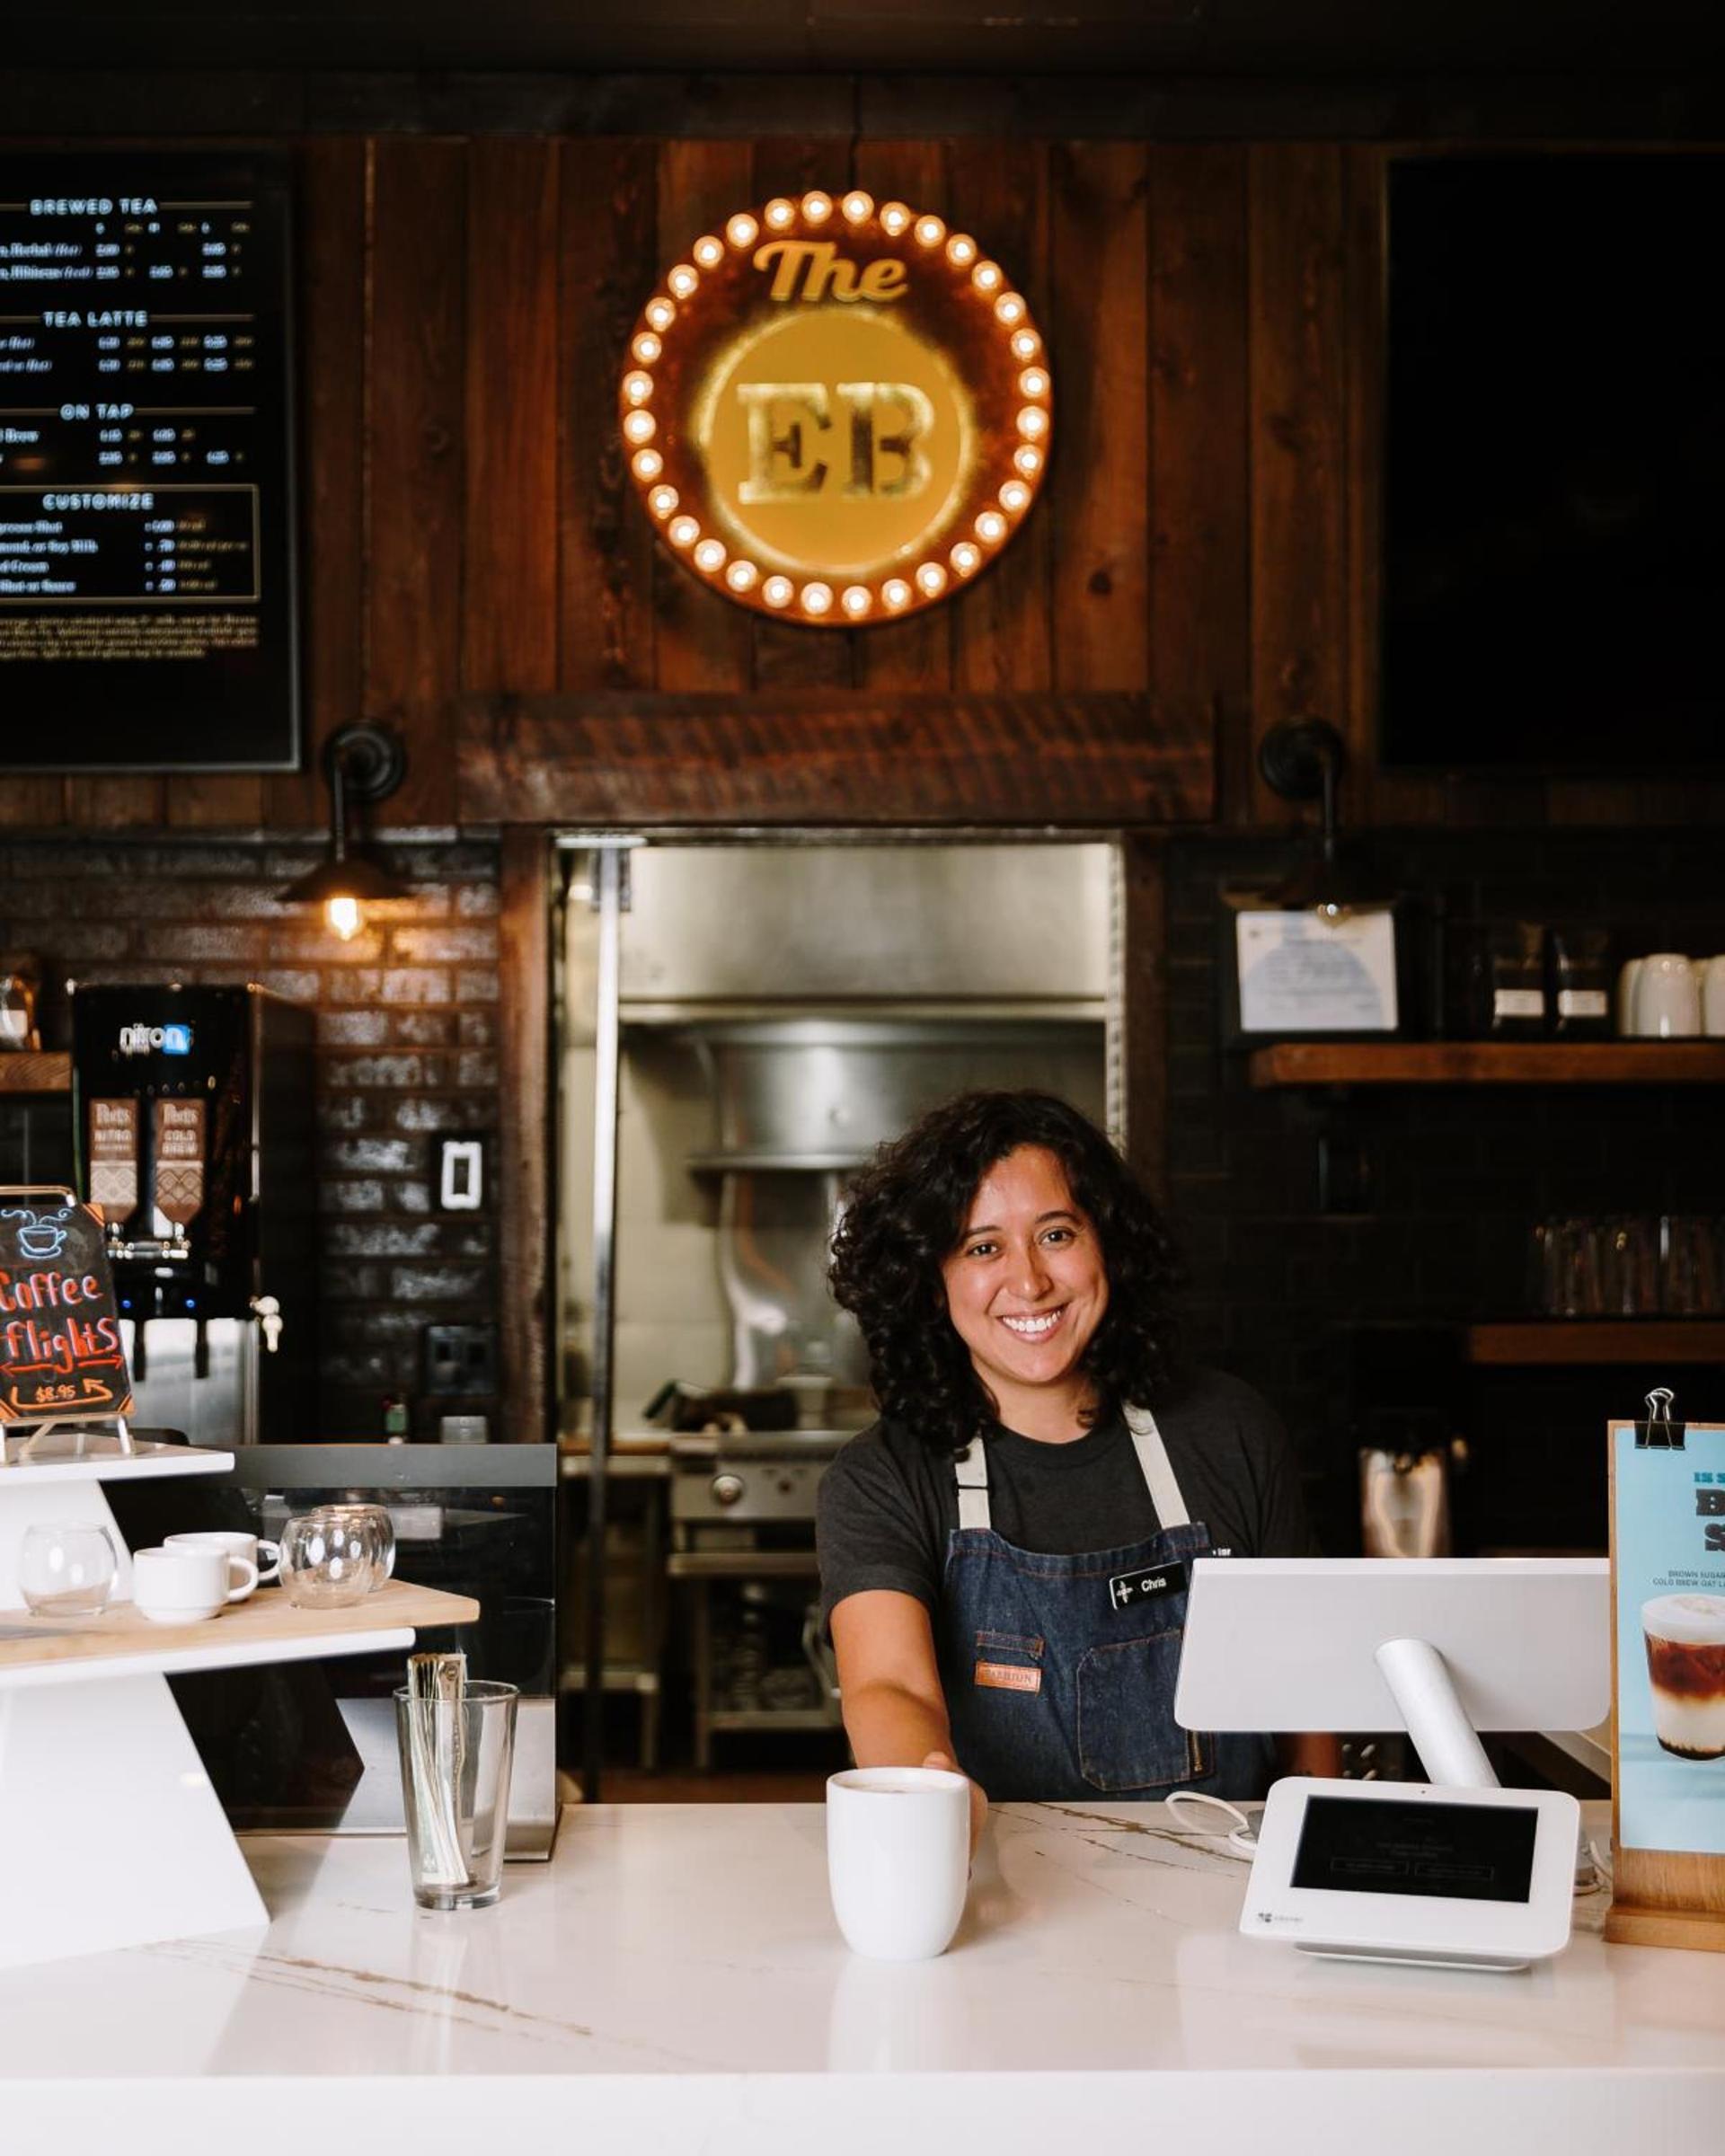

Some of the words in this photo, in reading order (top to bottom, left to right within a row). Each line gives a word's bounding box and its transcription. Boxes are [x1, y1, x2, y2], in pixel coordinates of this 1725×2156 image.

[30, 199, 113, 216] BREWED
[119, 199, 158, 215] TEA
[753, 240, 908, 303] The
[43, 312, 82, 327] TEA
[87, 312, 148, 327] LATTE
[59, 403, 90, 420] ON
[95, 403, 134, 420] TAP
[736, 382, 934, 505] EB
[42, 493, 154, 510] CUSTOMIZE
[0, 1271, 103, 1312] Coffee
[35, 1384, 76, 1404] $8.95
[1652, 1578, 1674, 1586] COLD
[1676, 1578, 1698, 1586] BREW
[1668, 1570, 1698, 1578] BROWN
[1140, 1577, 1167, 1592] Chris
